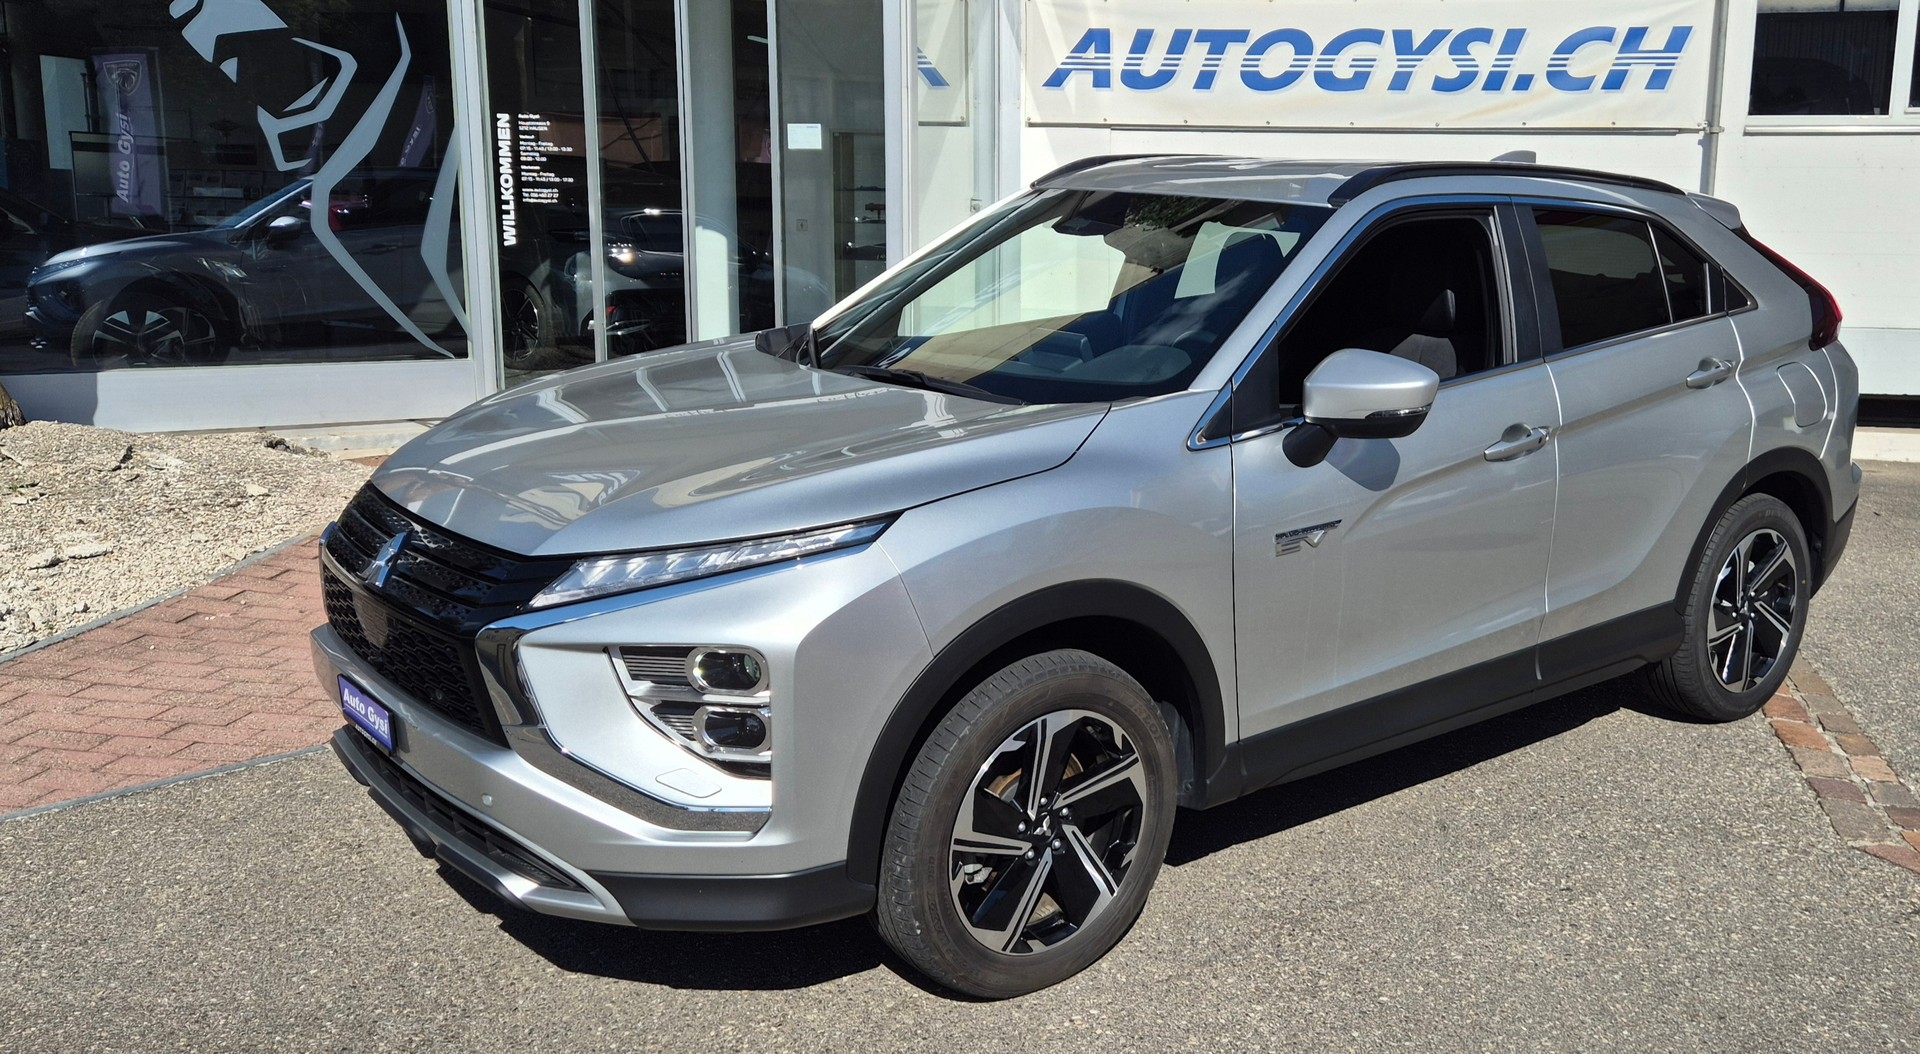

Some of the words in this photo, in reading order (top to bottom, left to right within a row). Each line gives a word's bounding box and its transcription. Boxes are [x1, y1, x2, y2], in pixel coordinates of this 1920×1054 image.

[1041, 26, 1694, 92] AUTOGYSI.CH
[116, 112, 134, 156] Gysi
[116, 160, 130, 203] Auto
[496, 113, 517, 247] WILLKOMMEN
[343, 688, 366, 715] Auto
[367, 706, 388, 735] Gysi
